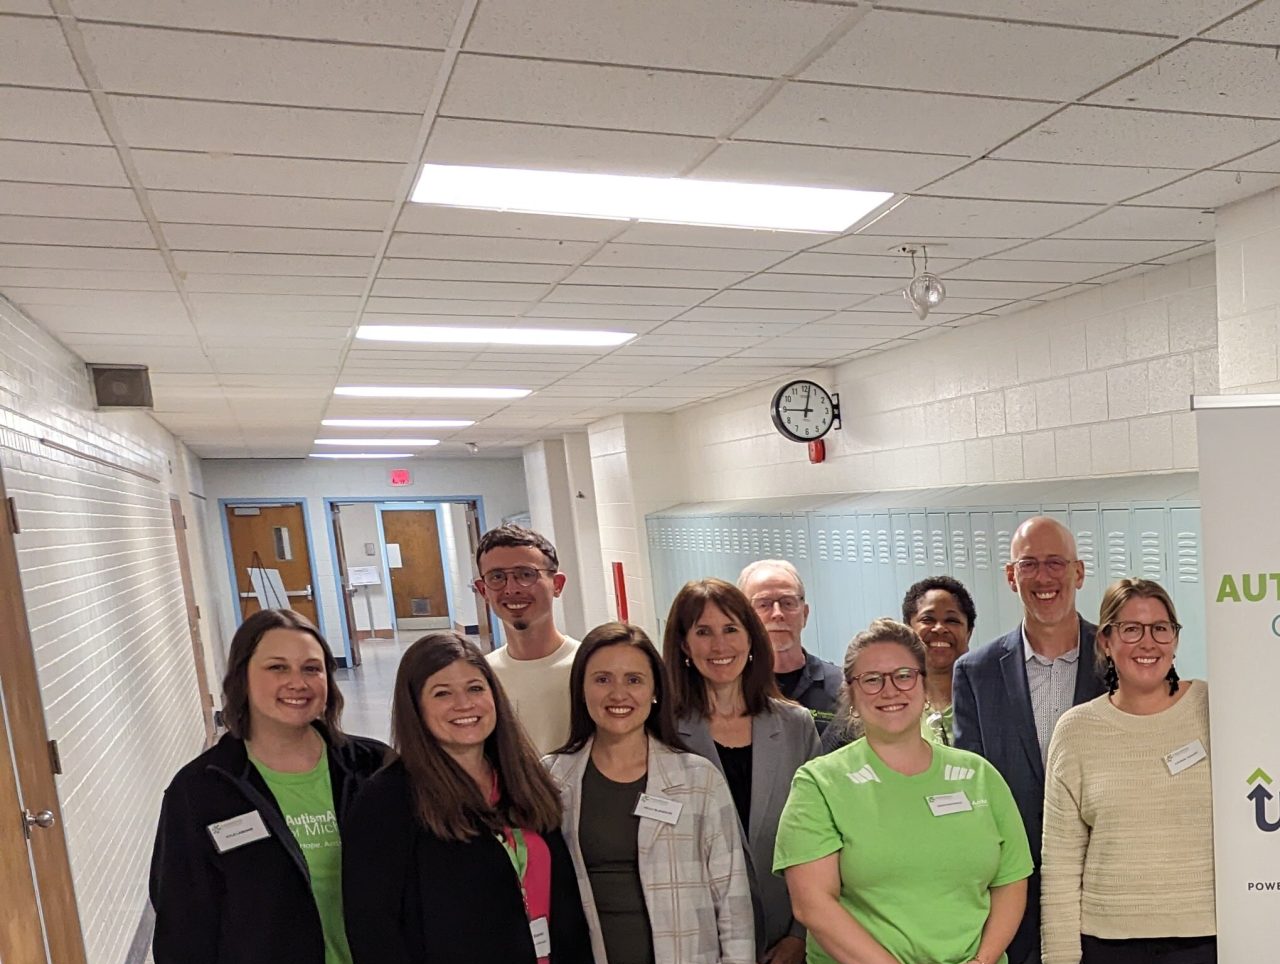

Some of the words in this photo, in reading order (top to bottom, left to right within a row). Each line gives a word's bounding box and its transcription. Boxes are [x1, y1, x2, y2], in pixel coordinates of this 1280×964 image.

[801, 385, 809, 393] 12
[785, 395, 792, 403] 10
[820, 396, 825, 404] 2
[825, 407, 829, 415] 3
[787, 416, 792, 424] 8
[815, 425, 820, 433] 5
